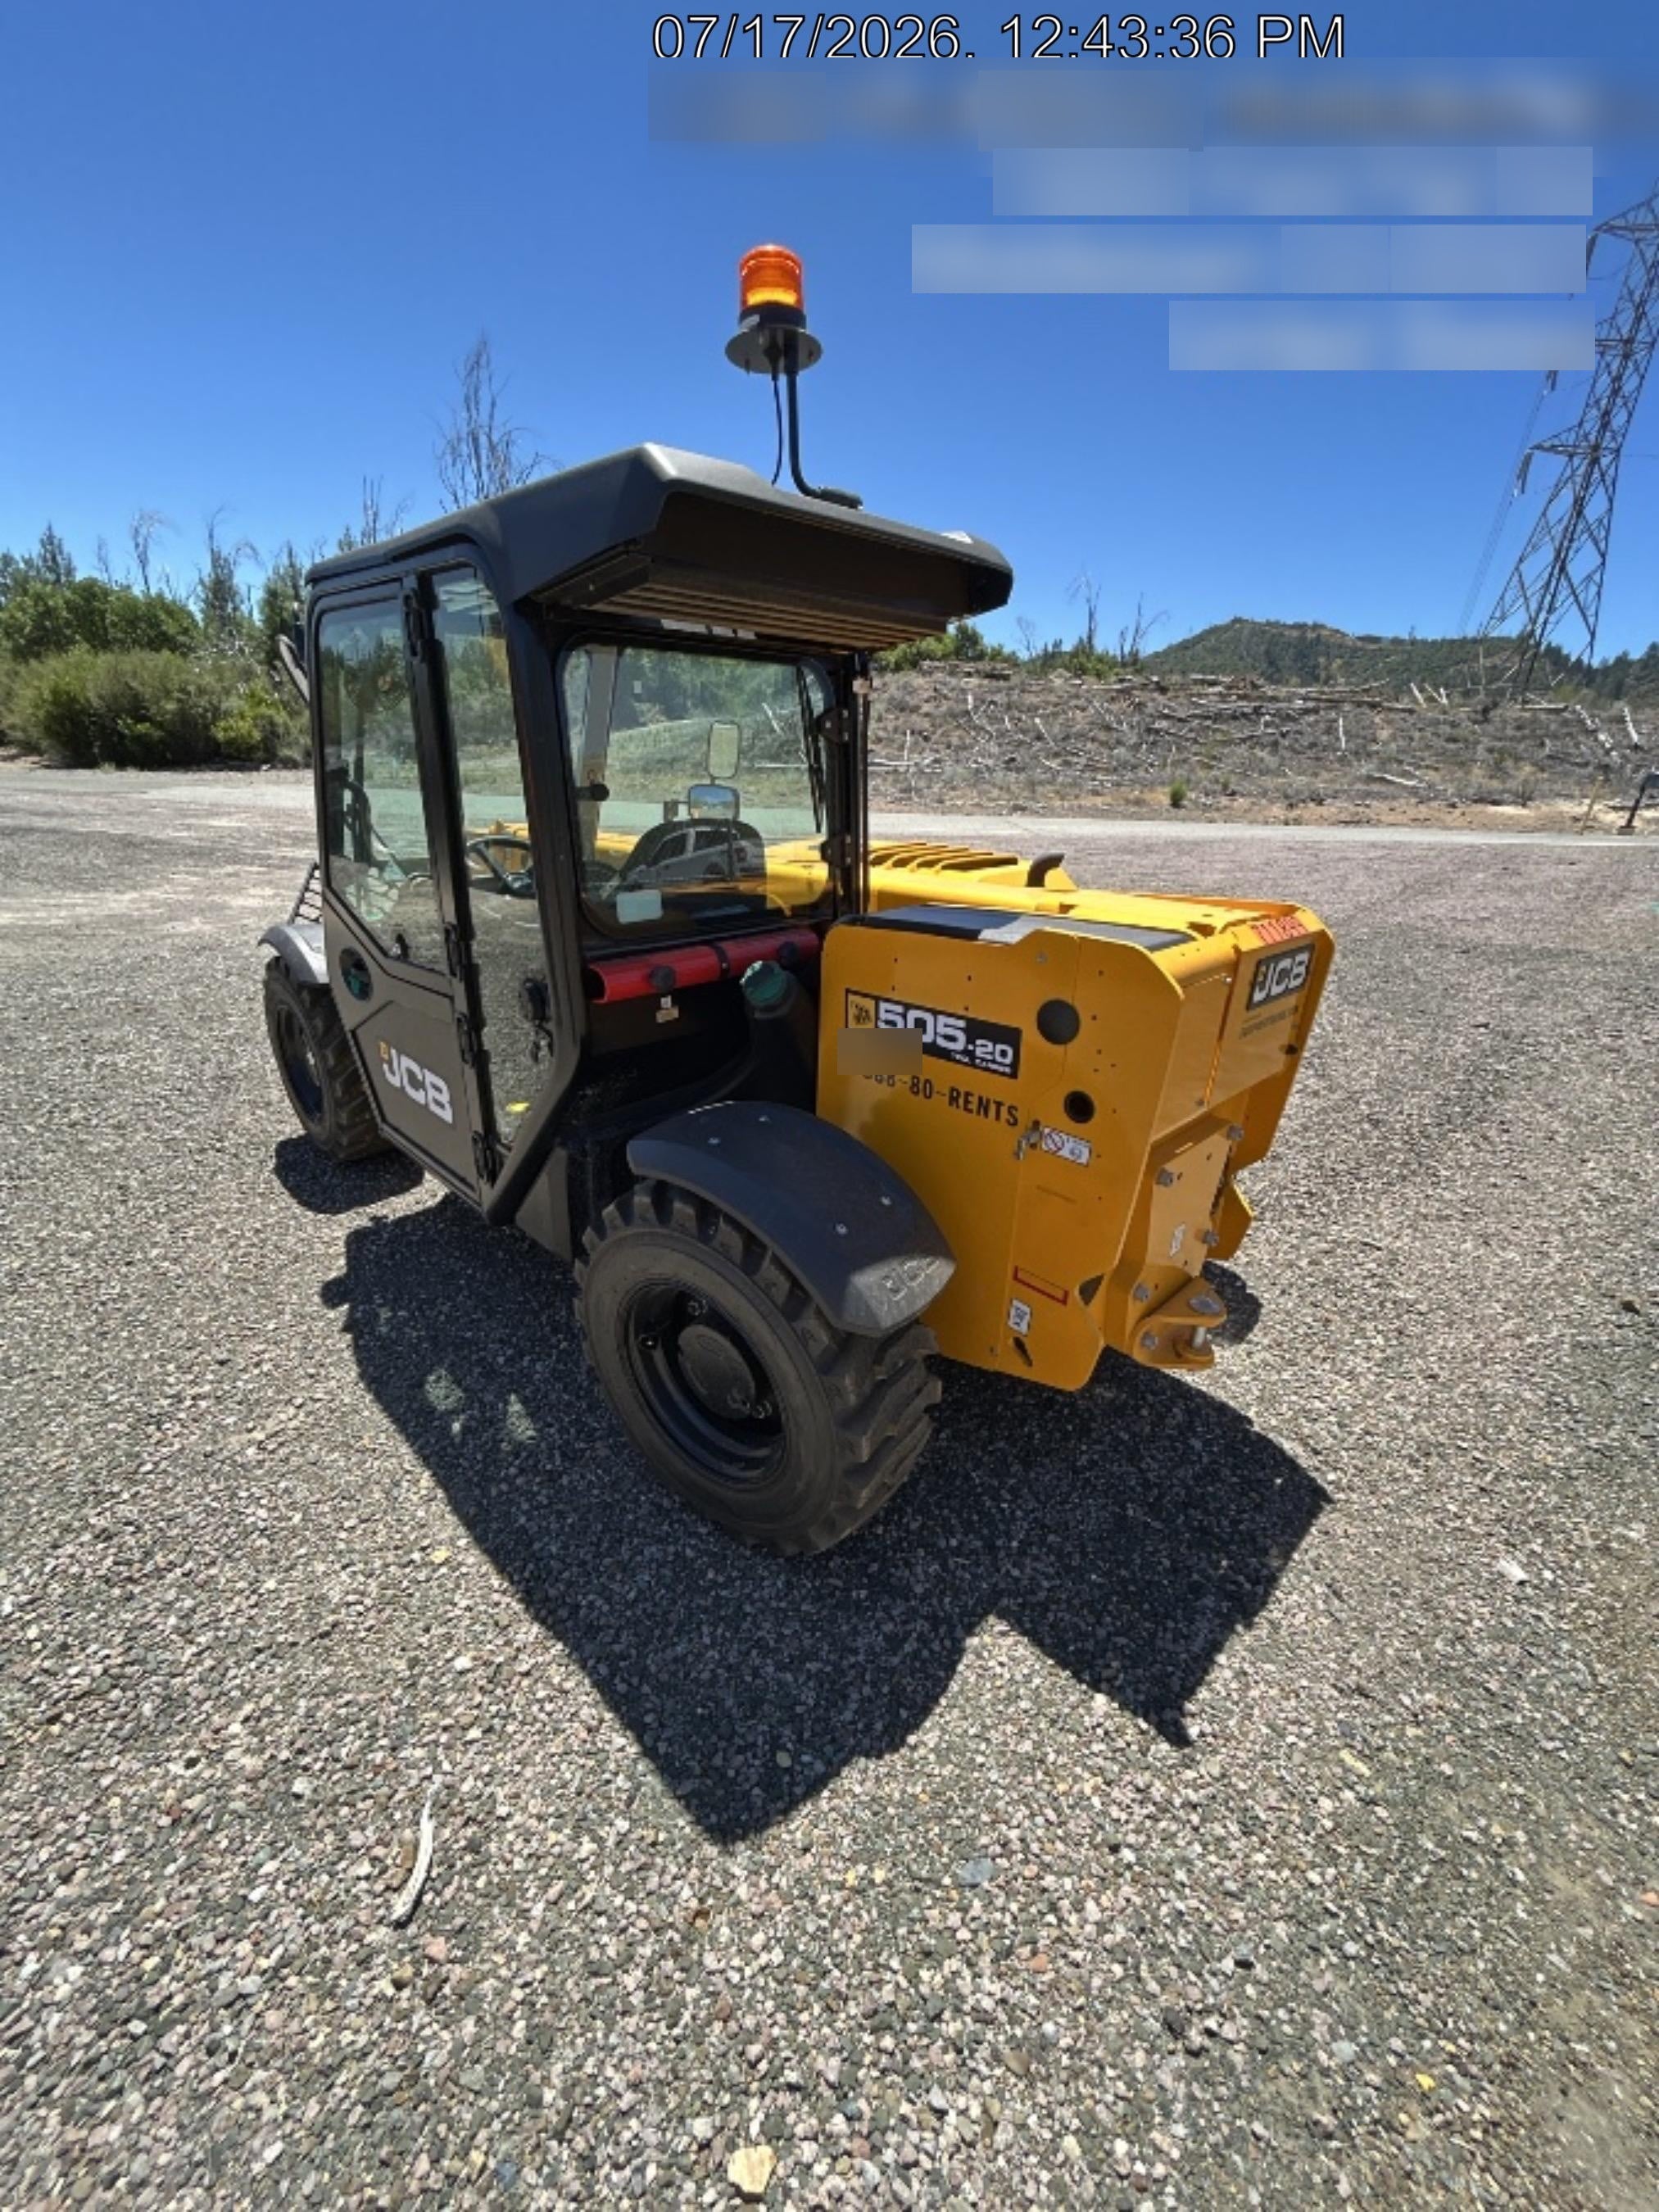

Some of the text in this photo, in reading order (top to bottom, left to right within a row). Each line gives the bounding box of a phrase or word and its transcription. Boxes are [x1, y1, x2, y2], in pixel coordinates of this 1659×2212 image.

[1253, 951, 1310, 1004] JCB
[379, 1041, 453, 1125] JCB
[862, 1074, 1019, 1127] 8-80-RENTS
